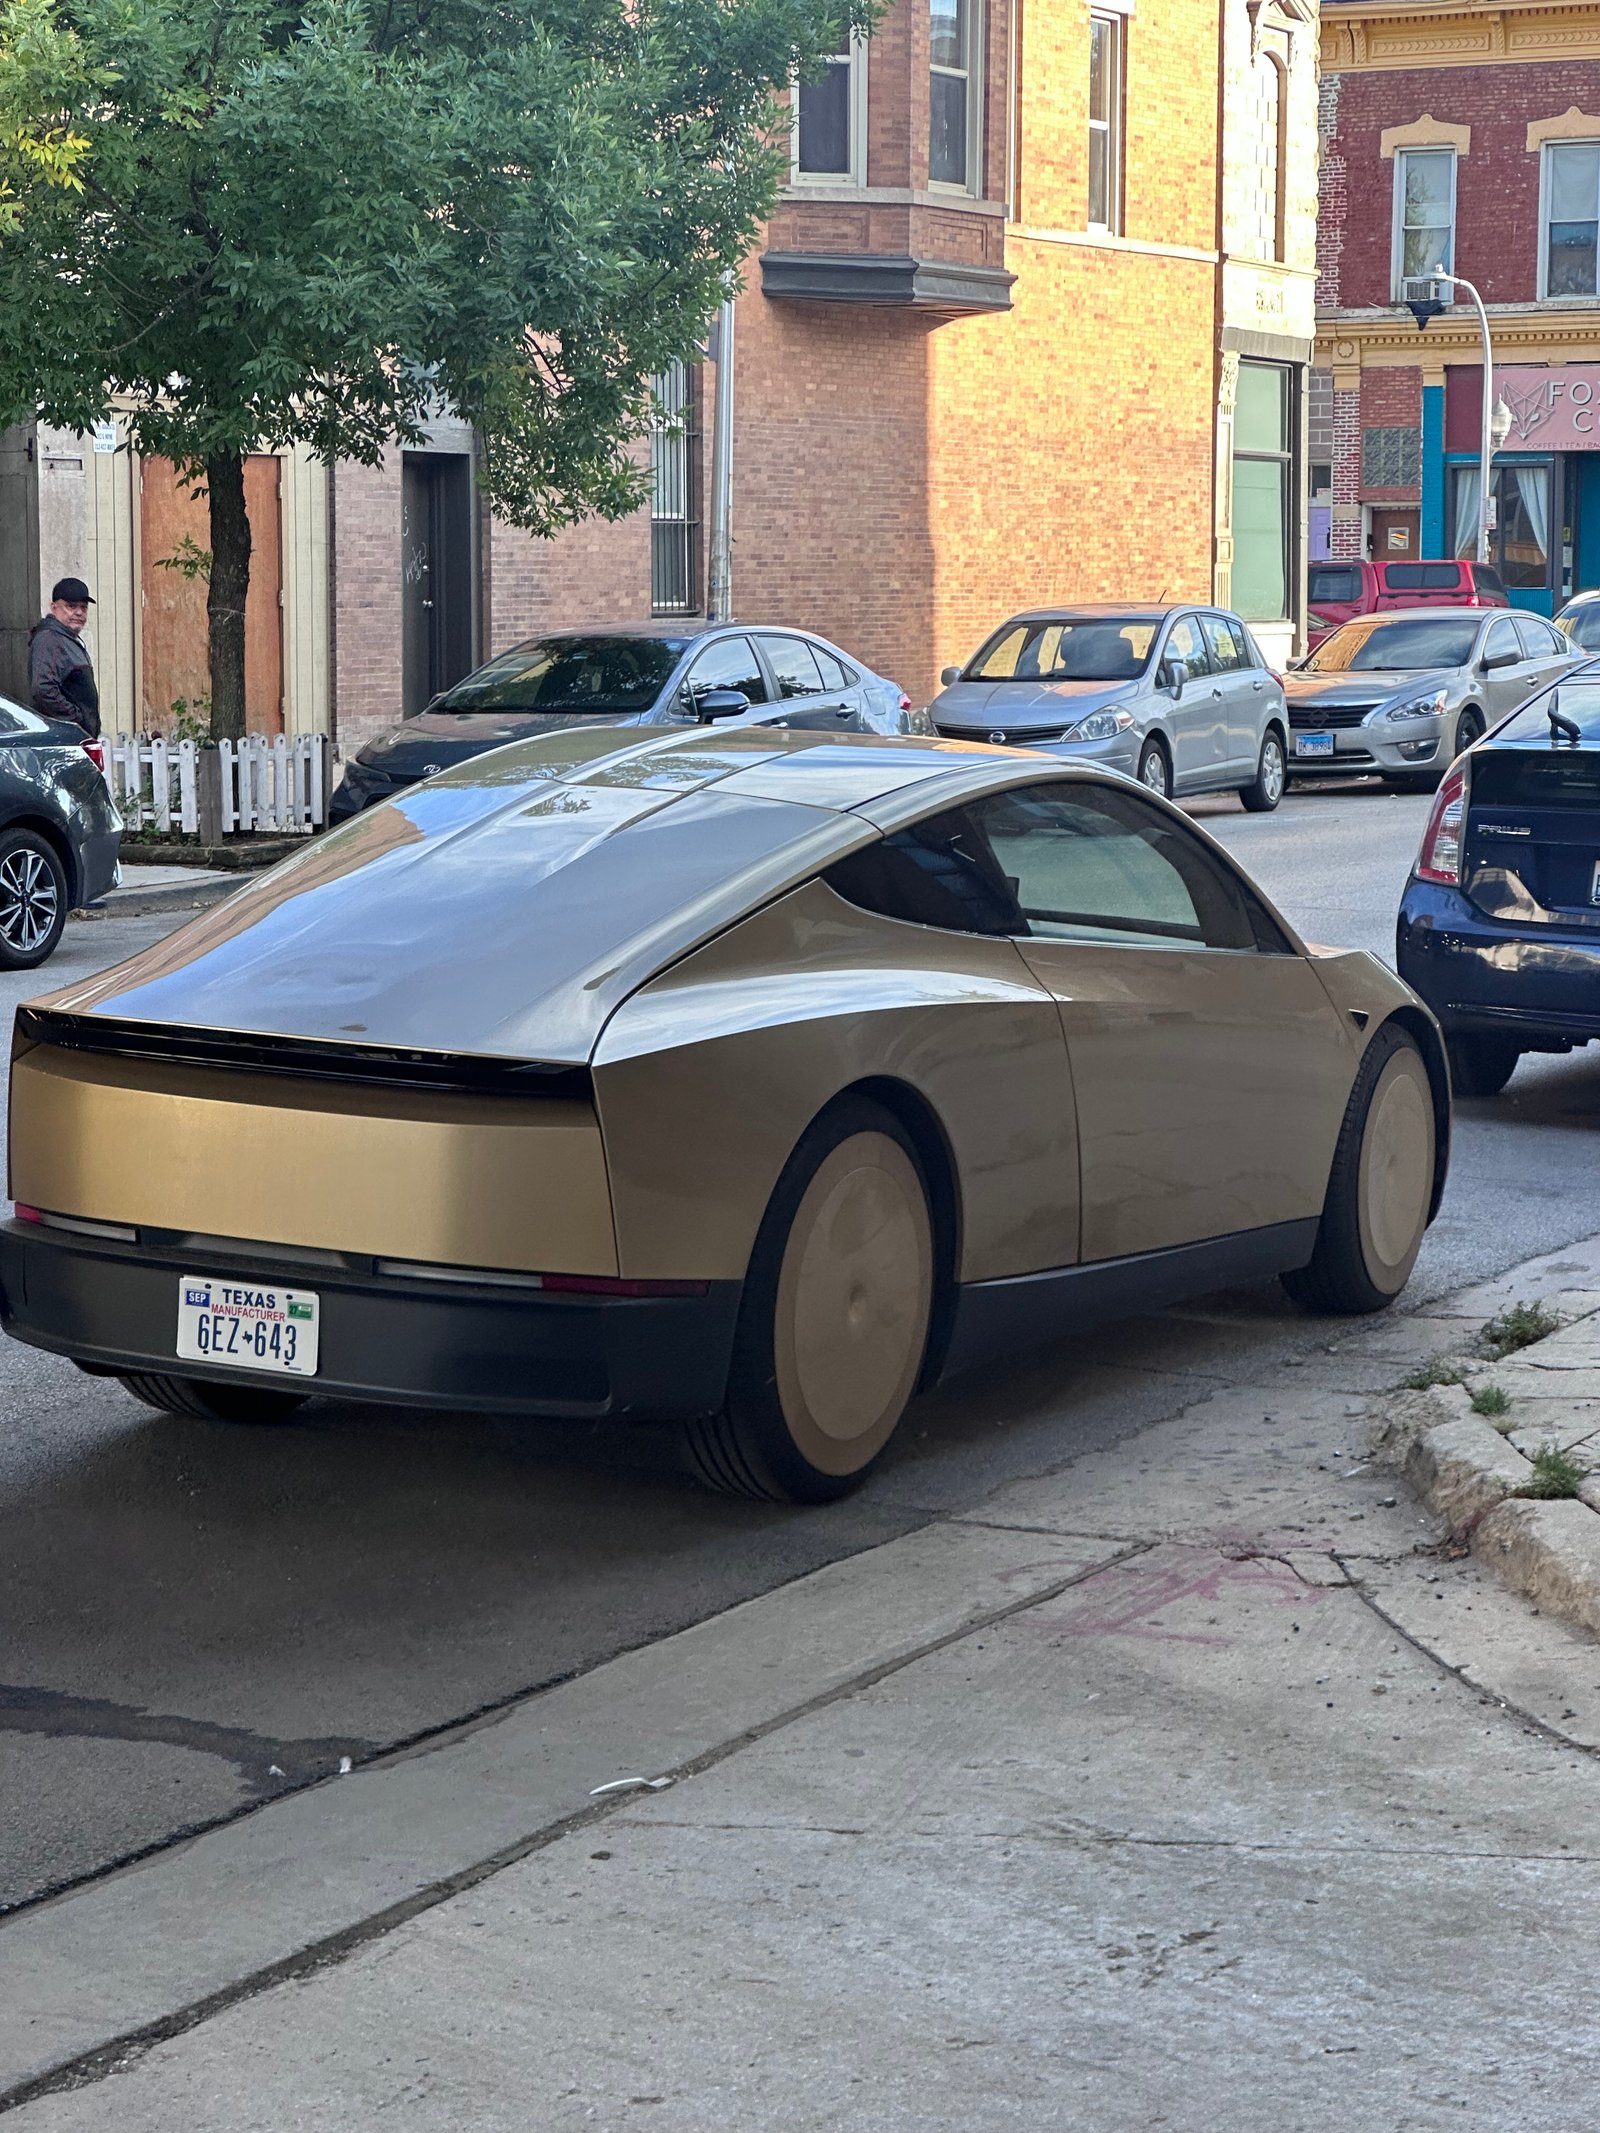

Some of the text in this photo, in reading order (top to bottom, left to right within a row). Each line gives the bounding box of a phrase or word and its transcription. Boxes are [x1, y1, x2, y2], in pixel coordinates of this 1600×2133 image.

[1549, 381, 1600, 406] FO
[1526, 442, 1557, 450] COFFEE
[1566, 441, 1580, 449] TEA
[1477, 824, 1531, 835] PRIUS
[188, 1291, 206, 1303] SEP
[222, 1288, 276, 1309] TEXAS
[210, 1304, 286, 1322] MANUFACTURER
